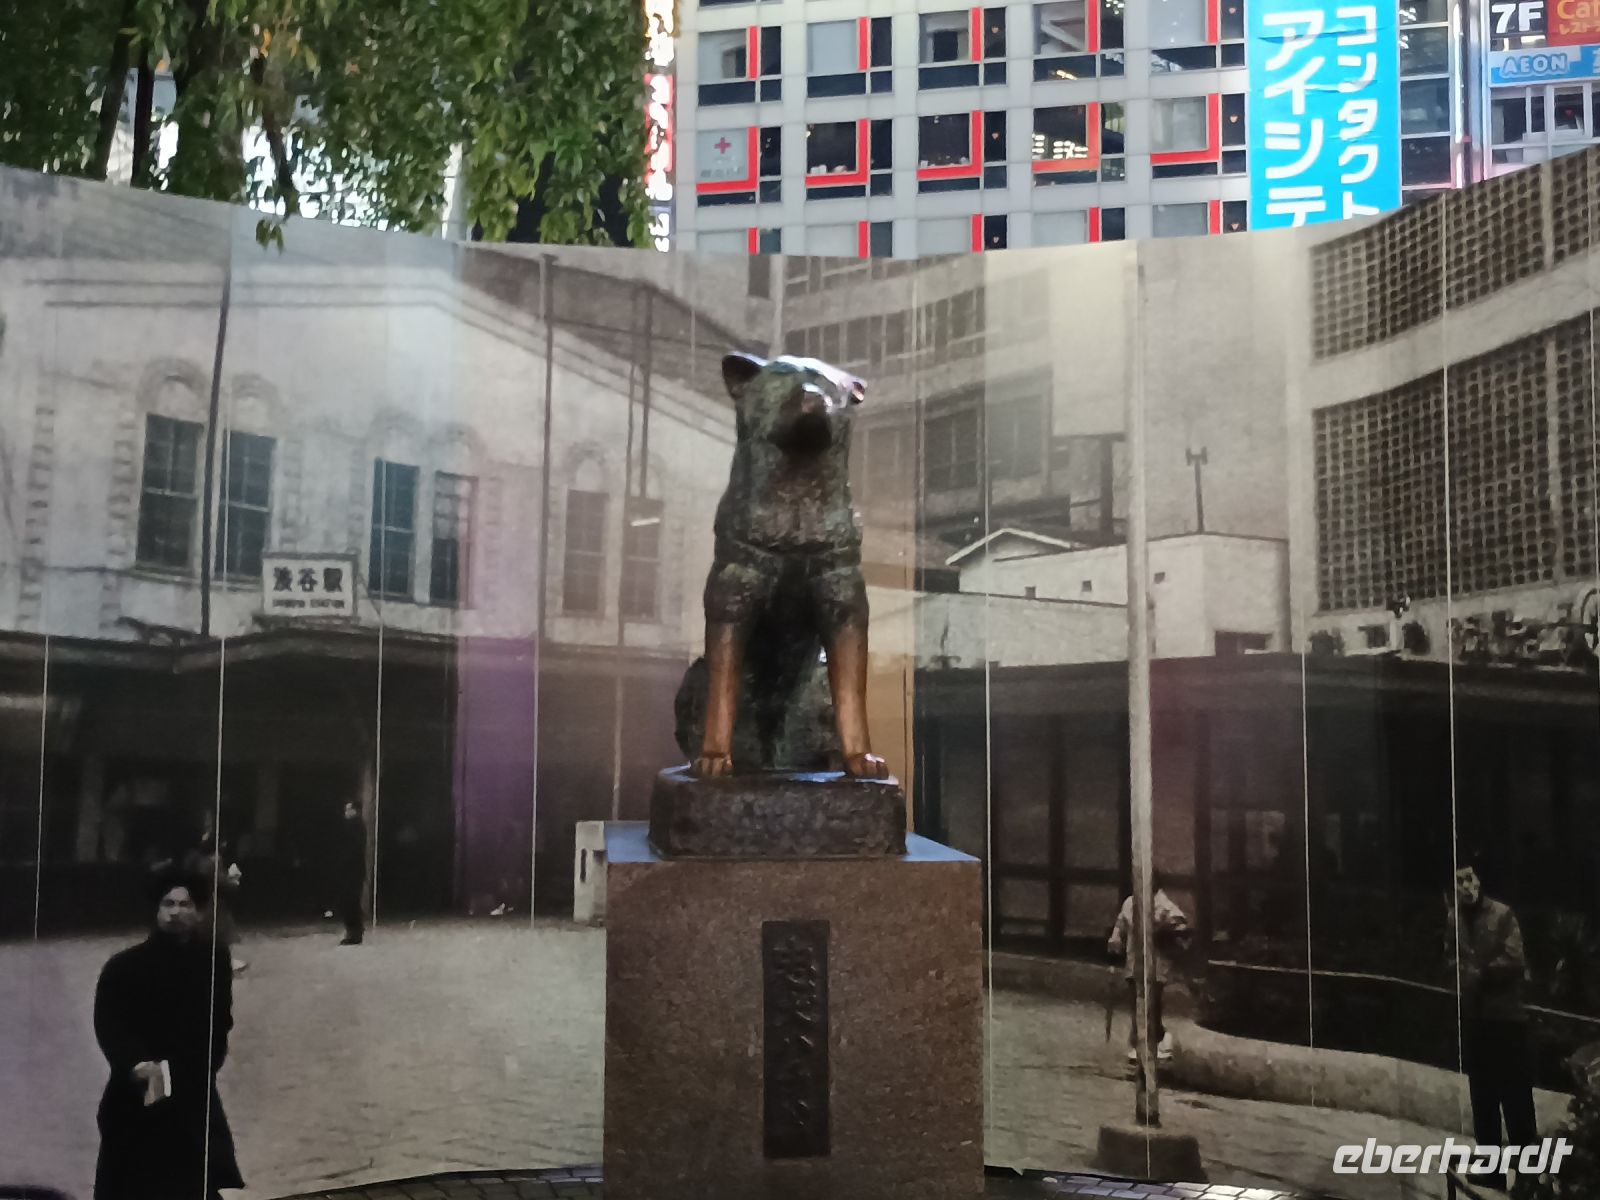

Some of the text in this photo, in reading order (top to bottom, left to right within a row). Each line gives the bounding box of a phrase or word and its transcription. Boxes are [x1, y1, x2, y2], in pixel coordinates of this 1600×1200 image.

[1492, 1, 1544, 34] 7F
[1502, 53, 1567, 77] AEON
[1264, 9, 1326, 228] アイシテ
[1336, 5, 1380, 219] コンタクト
